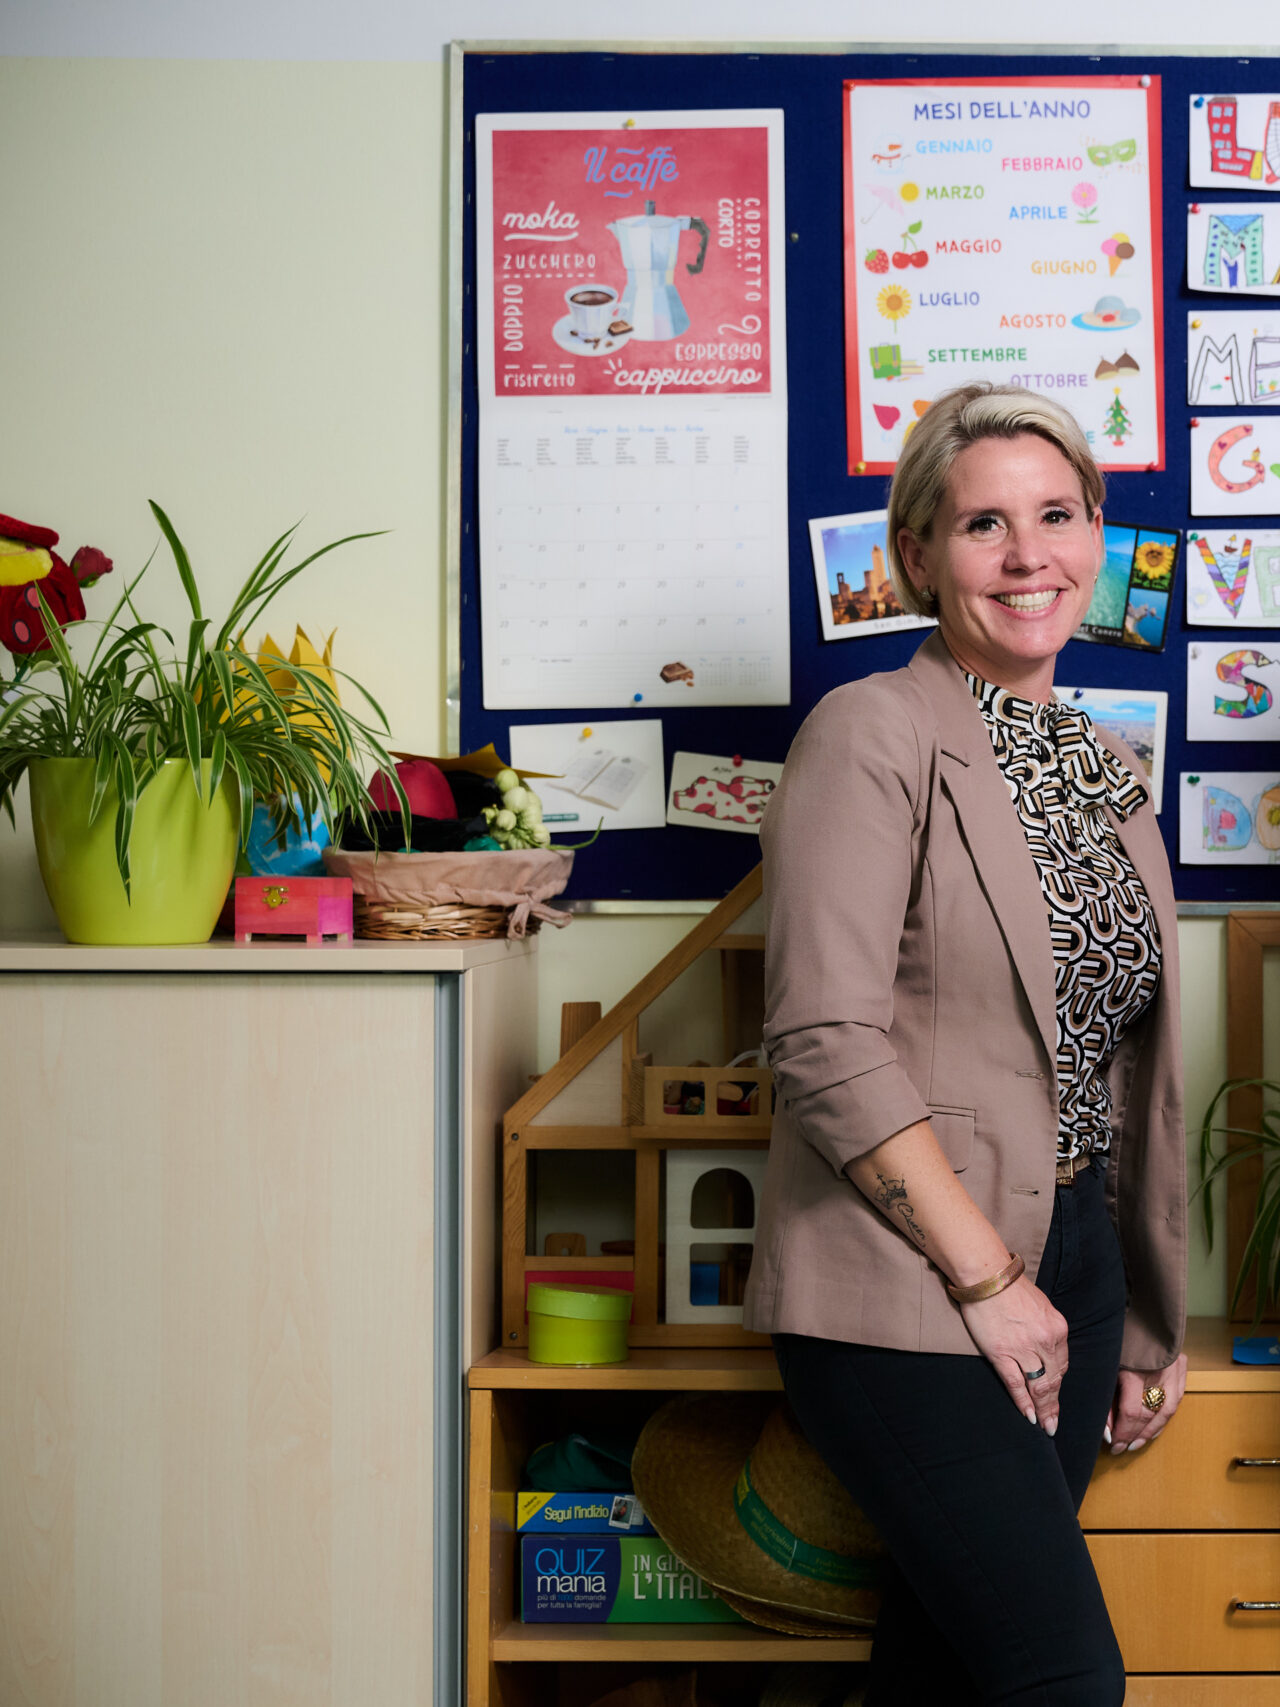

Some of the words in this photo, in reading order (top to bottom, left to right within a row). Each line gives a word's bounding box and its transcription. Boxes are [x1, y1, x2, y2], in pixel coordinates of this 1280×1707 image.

[914, 102, 963, 121] MESI
[970, 100, 1091, 120] DELL'ANNO
[915, 139, 993, 154] GENNAIO
[584, 146, 605, 183] Il
[611, 146, 679, 191] caffè
[1002, 157, 1083, 172] FEBBRAIO
[926, 185, 985, 200] MARZO
[502, 201, 580, 230] moka
[1008, 205, 1068, 220] APRILE
[718, 198, 734, 248] CORTO
[745, 197, 762, 302] CORRETTO
[935, 239, 1002, 254] MAGGIO
[503, 253, 597, 270] ZUCCHERO
[1031, 260, 1098, 275] GIUGNO
[918, 291, 981, 306] LUGLIO
[503, 284, 524, 352] DOPPIO
[999, 314, 1067, 329] AGOSTO
[675, 342, 762, 361] ESPRESSO
[927, 348, 1028, 363] SETTEMBRE
[503, 373, 576, 388] ristretto
[613, 366, 762, 395] cappuccino
[1010, 373, 1089, 389] OTTOBRE
[543, 1506, 572, 1523] Segui
[573, 1504, 609, 1520] l'indizio
[535, 1548, 606, 1576] QUIZ
[633, 1554, 651, 1572] IN
[537, 1574, 607, 1593] mania
[537, 1594, 548, 1602] più
[549, 1593, 556, 1601] di
[574, 1593, 607, 1601] domande
[537, 1602, 549, 1610] per
[550, 1601, 565, 1609] tutta
[566, 1601, 573, 1609] la
